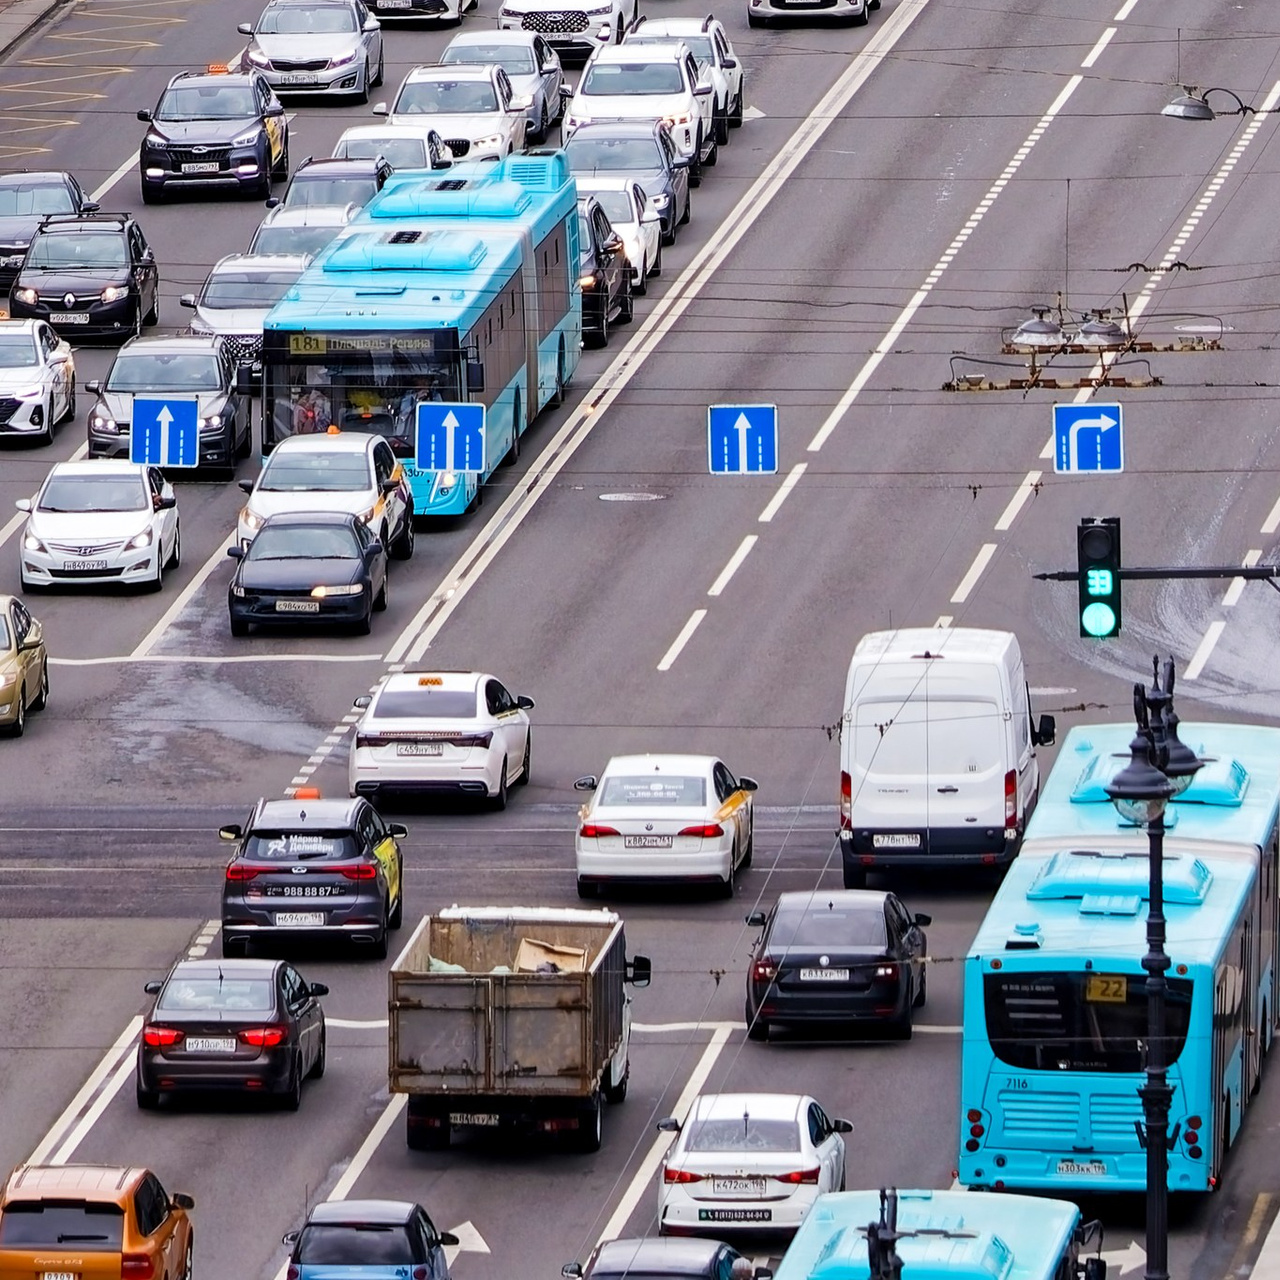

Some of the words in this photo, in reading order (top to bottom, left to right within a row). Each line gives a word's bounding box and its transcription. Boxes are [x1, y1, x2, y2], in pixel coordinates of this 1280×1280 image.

[330, 339, 387, 351] Площадь
[289, 835, 323, 844] Маркет
[288, 842, 334, 852] Деливери
[283, 886, 303, 896] 988
[304, 886, 318, 896] 88
[318, 886, 332, 896] 87
[1099, 980, 1124, 998] 22
[1006, 1078, 1029, 1089] 7116
